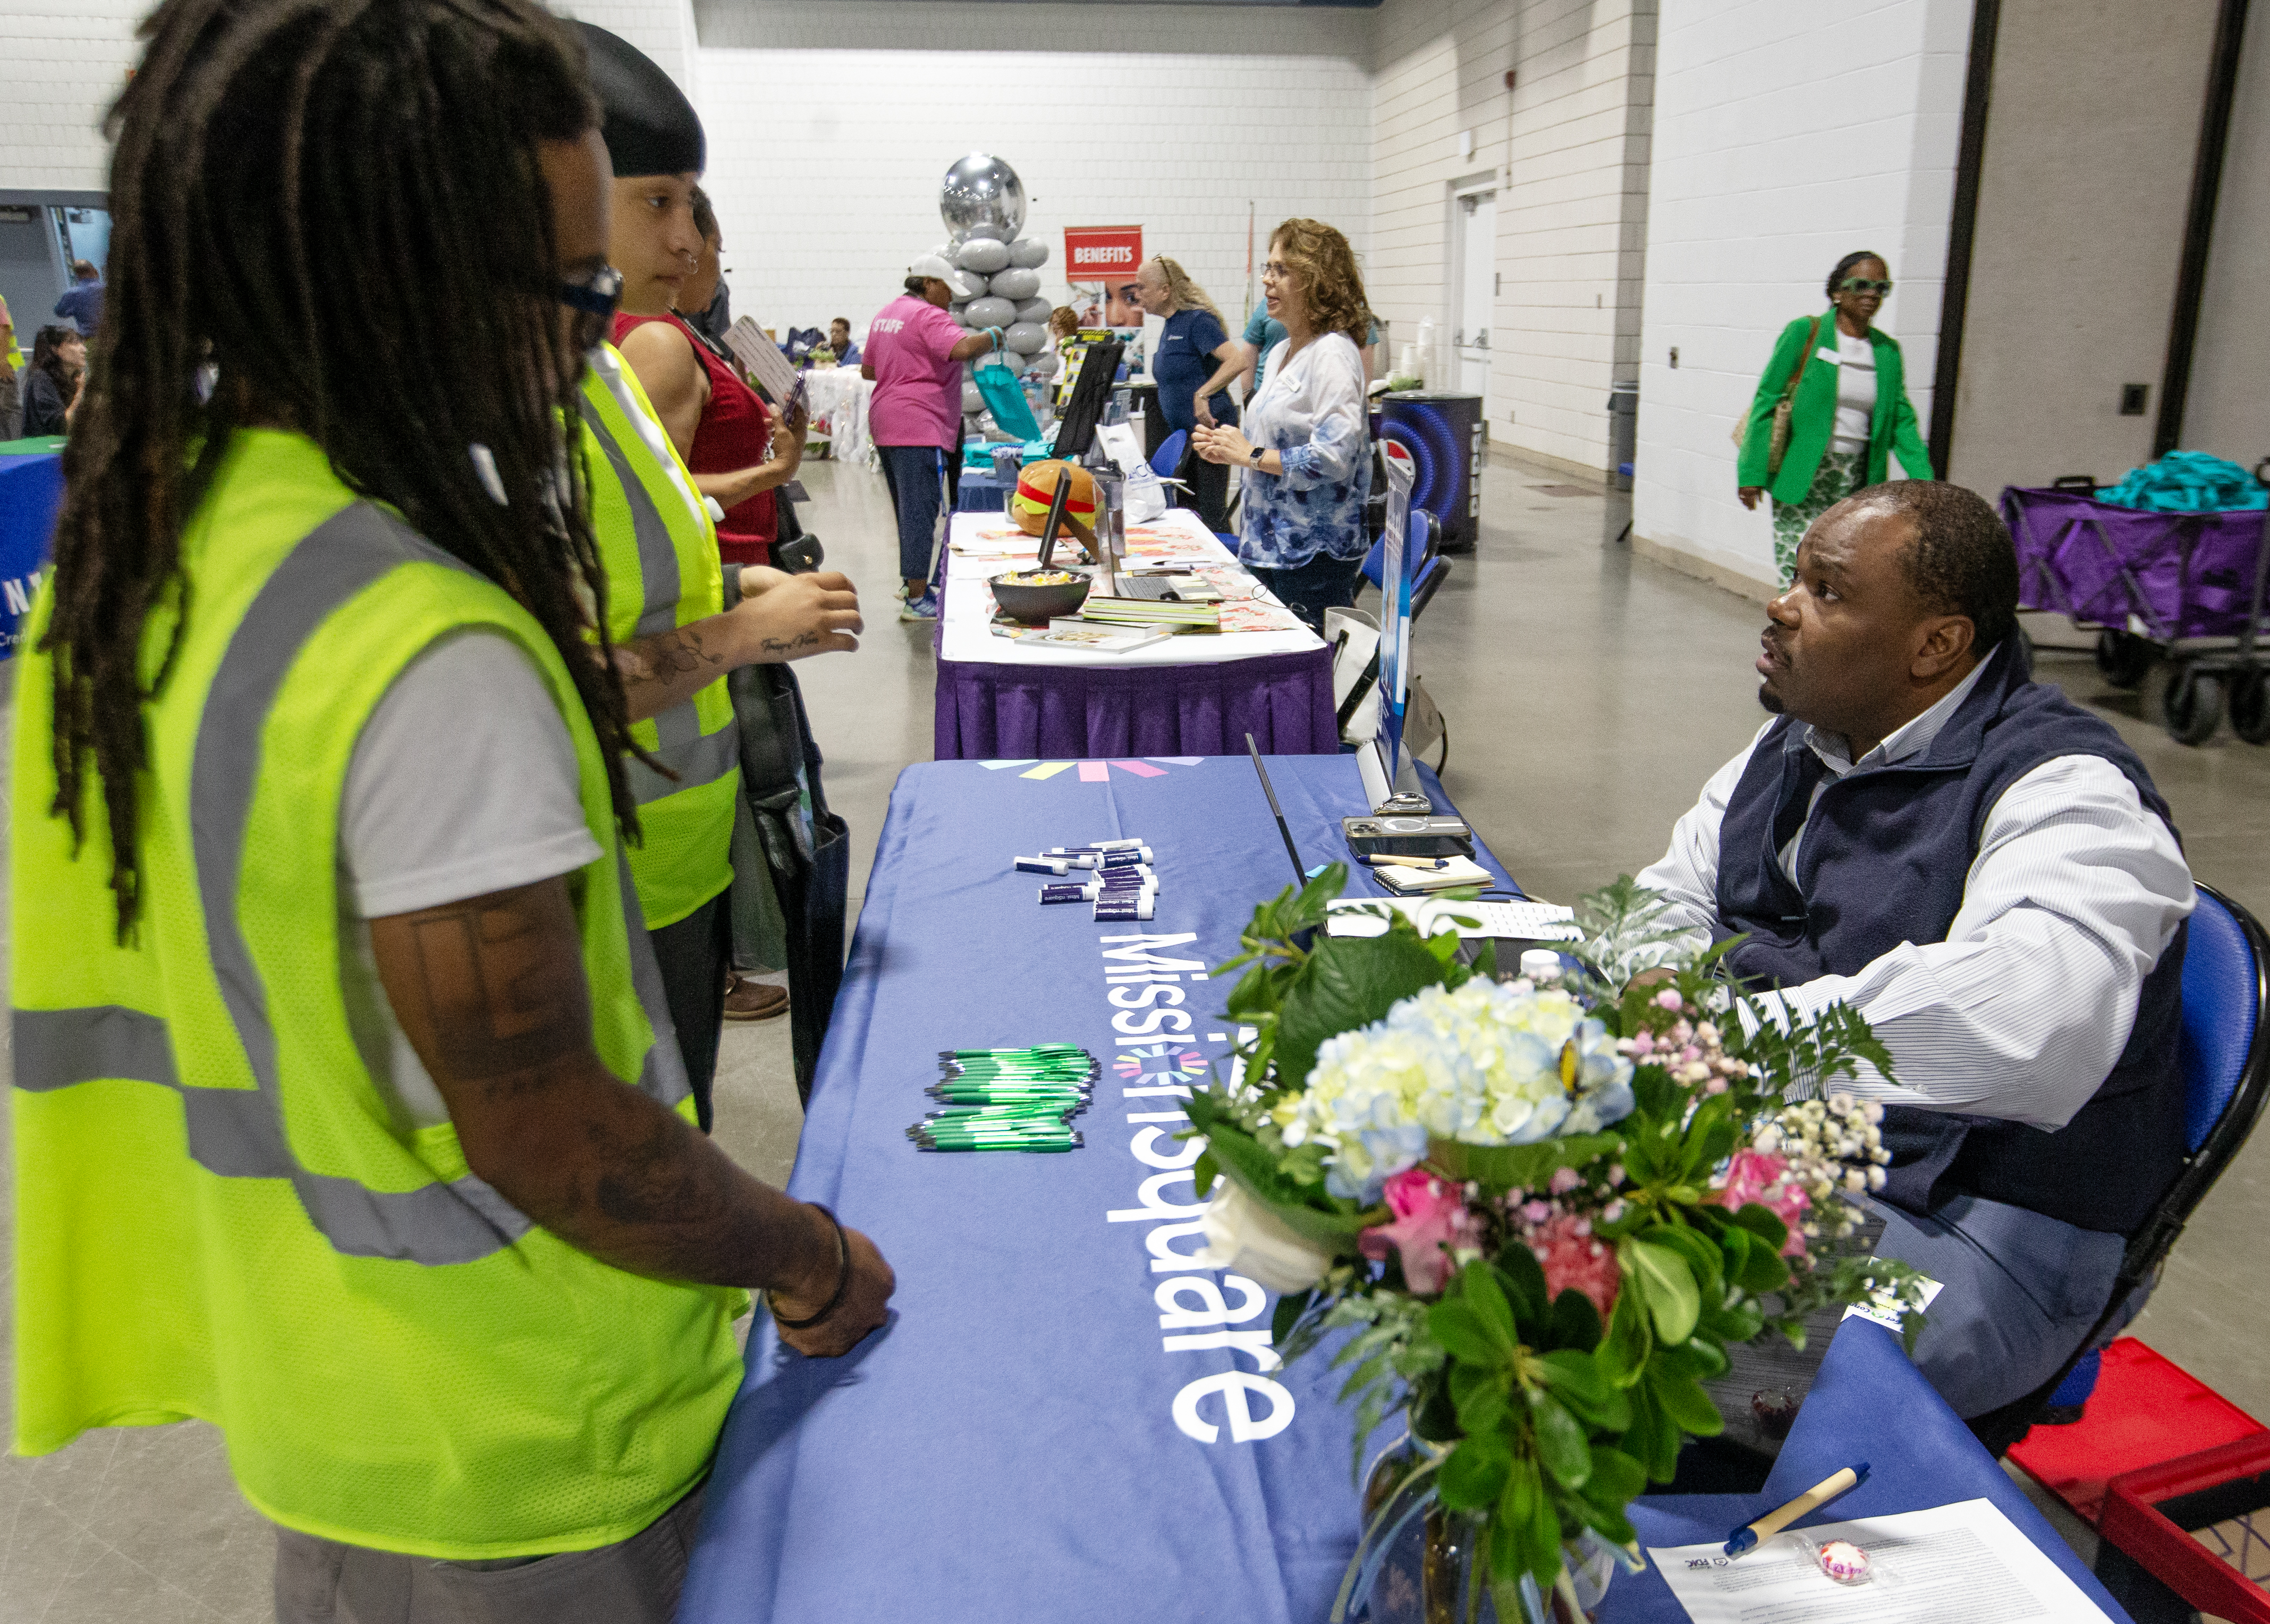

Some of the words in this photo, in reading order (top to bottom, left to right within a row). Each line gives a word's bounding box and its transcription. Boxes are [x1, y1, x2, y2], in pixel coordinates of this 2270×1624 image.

[1074, 246, 1133, 264] BENEFITS
[874, 319, 904, 334] STAFF
[1685, 1559, 1710, 1568] FDIC
